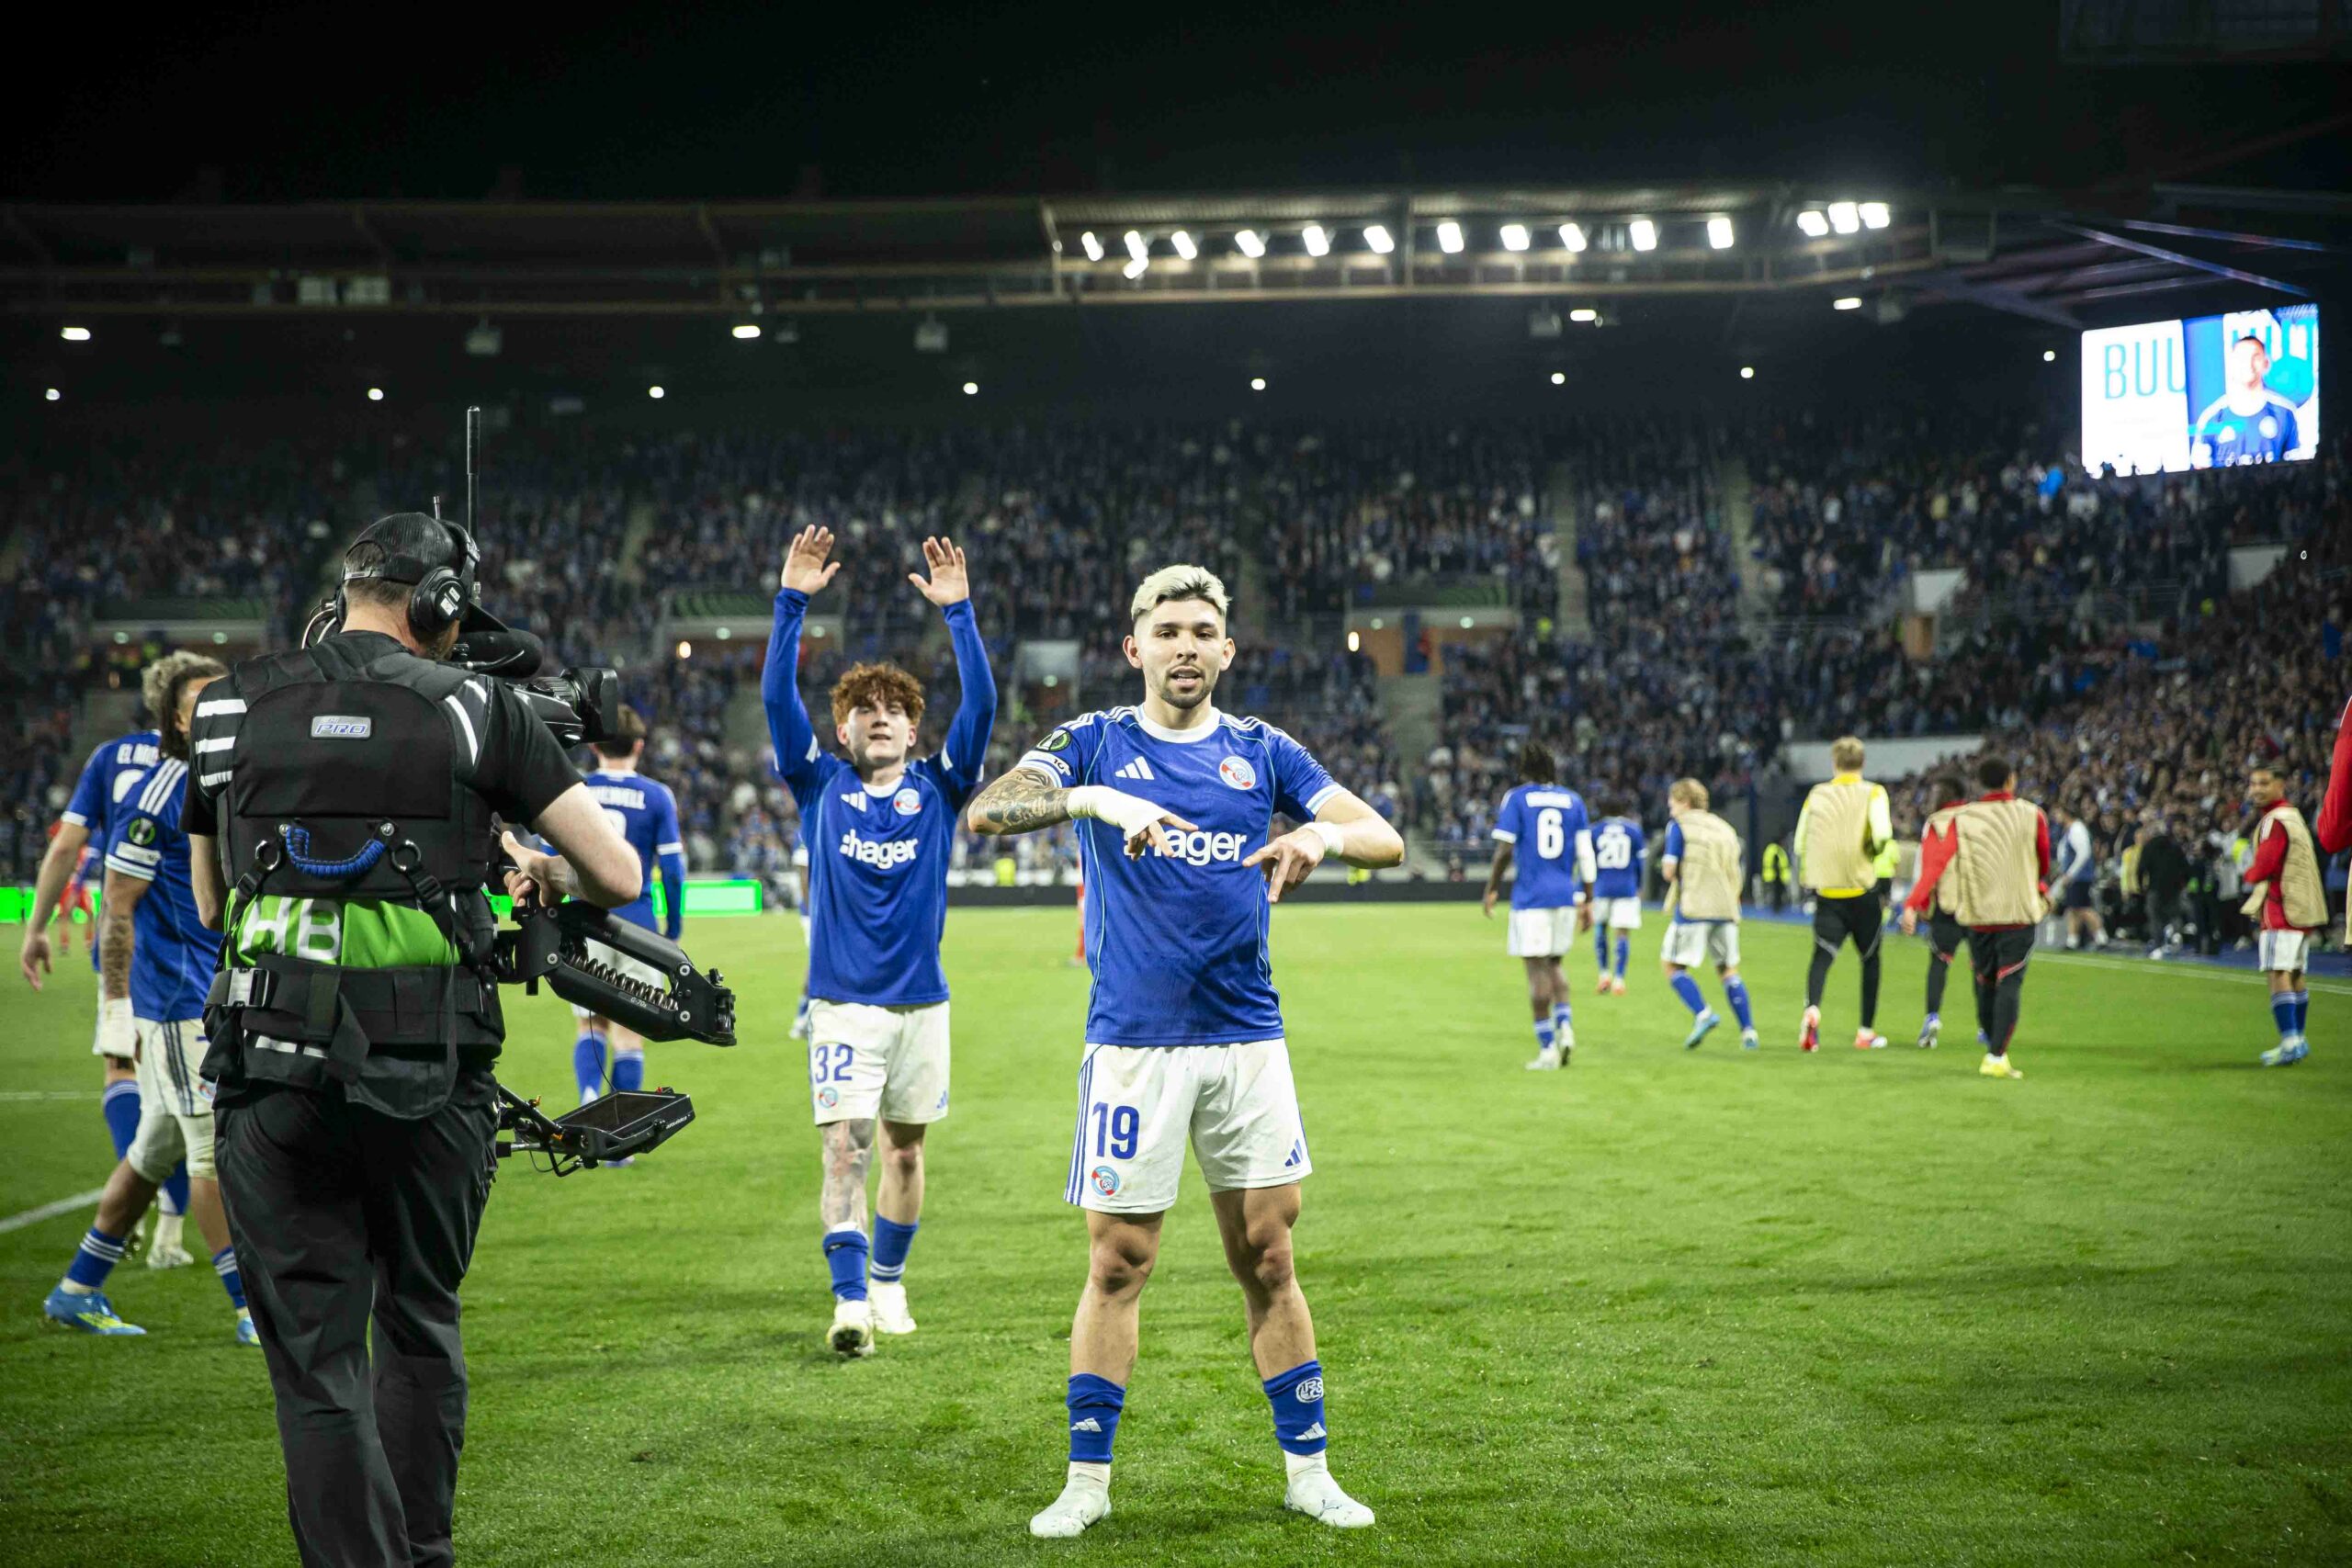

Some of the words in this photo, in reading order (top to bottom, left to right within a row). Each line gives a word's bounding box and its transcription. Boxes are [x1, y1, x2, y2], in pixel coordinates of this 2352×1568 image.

[314, 723, 368, 735] PRO
[1124, 829, 1247, 866] ager
[1537, 808, 1564, 860] 6
[1597, 833, 1632, 869] 20
[241, 897, 341, 961] HB
[815, 1043, 854, 1084] 32
[1092, 1101, 1139, 1160] 19
